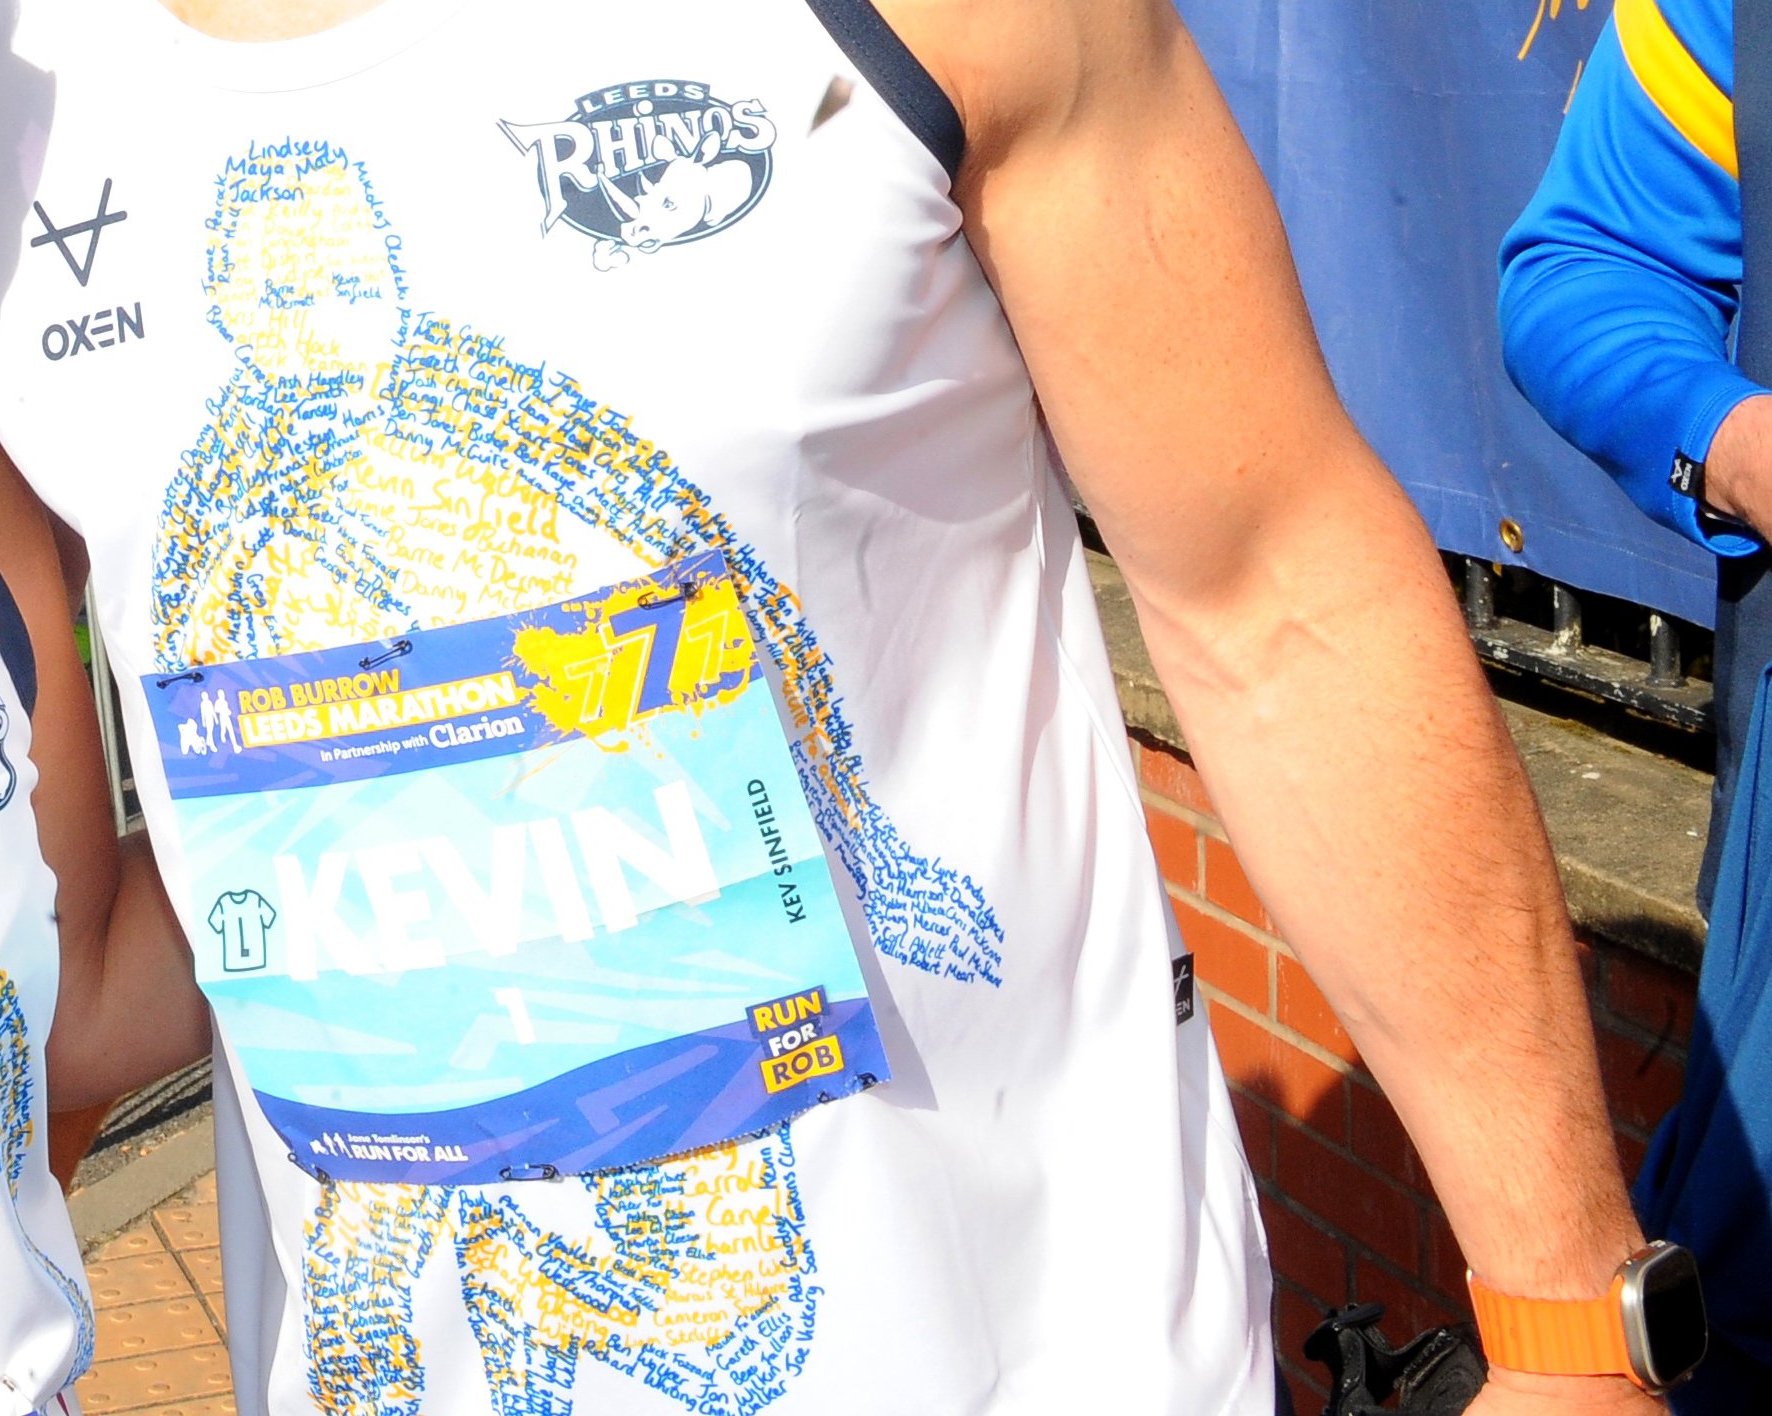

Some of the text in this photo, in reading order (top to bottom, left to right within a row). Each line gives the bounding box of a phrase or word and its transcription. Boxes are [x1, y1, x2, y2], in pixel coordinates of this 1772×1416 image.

[582, 82, 707, 114] LEEDS
[225, 155, 284, 186] Maya
[248, 136, 328, 161] Lindsey
[496, 98, 777, 239] RHINOS
[229, 177, 304, 203] Jackson
[42, 302, 145, 361] OXEN
[238, 668, 401, 714] ROB BURROW
[242, 675, 517, 745] LEEDS MARATHON
[320, 715, 526, 763] In Partnership with Clarion
[747, 779, 807, 924] KEV SINFIELD
[272, 780, 720, 980] KEVIN
[495, 987, 537, 1045] 1
[753, 991, 823, 1033] RUN
[768, 1022, 818, 1058] FOR
[771, 1044, 836, 1086] ROB
[350, 1145, 469, 1162] RUN FOR ALL
